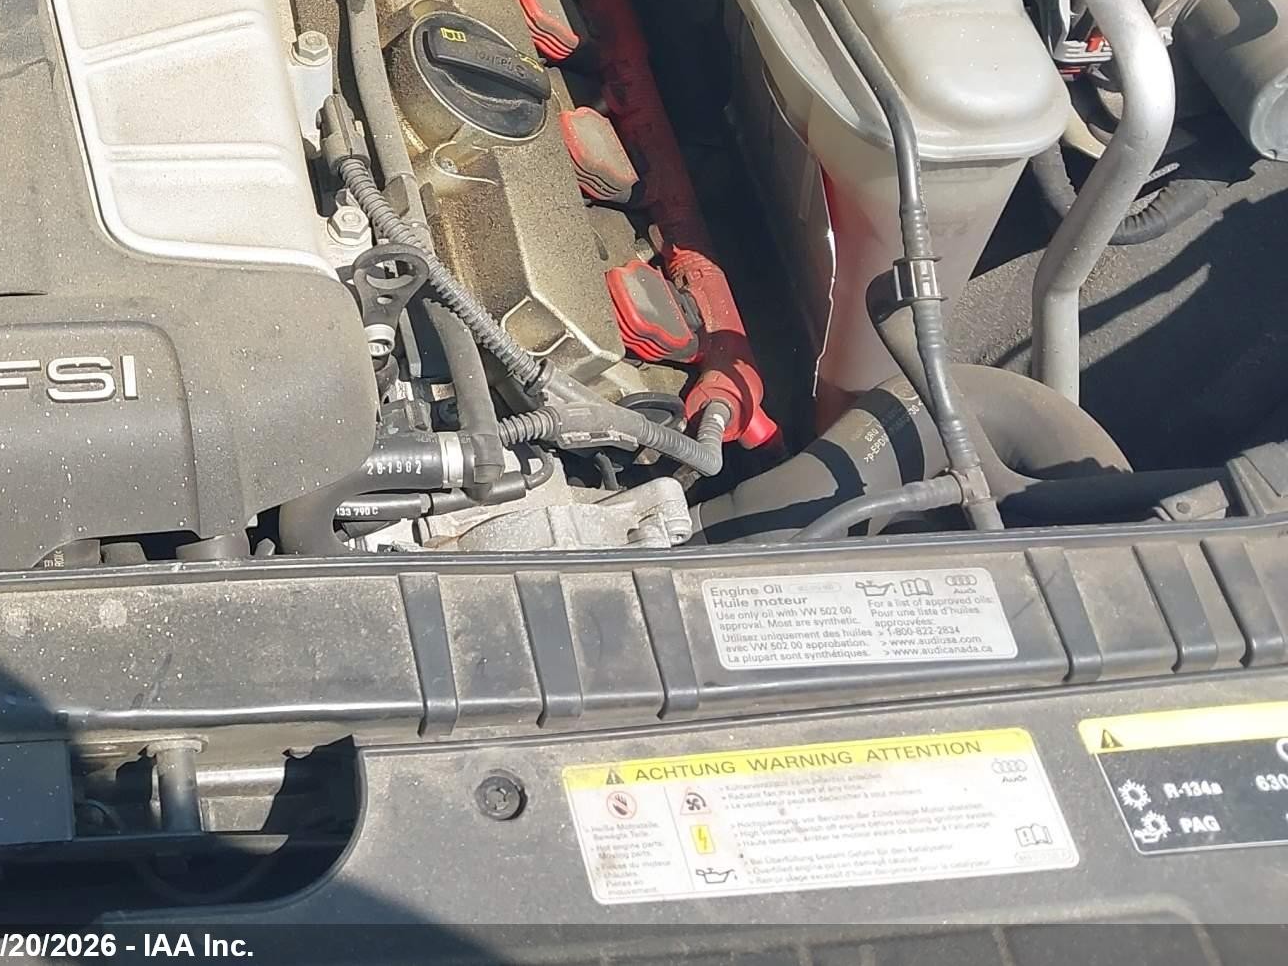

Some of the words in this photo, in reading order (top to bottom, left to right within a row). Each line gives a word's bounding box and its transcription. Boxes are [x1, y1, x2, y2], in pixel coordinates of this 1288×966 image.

[711, 585, 758, 599] Engine
[764, 584, 783, 595] Oil
[713, 597, 749, 609] Huile
[754, 595, 808, 607] moteur
[868, 599, 884, 609] For
[896, 598, 910, 608] list
[913, 597, 922, 607] of
[925, 596, 972, 608] approved
[716, 611, 736, 621] Use
[738, 609, 759, 621] only
[762, 609, 774, 619] oil
[778, 608, 798, 618] with
[800, 607, 817, 616] VW
[820, 606, 837, 616] 502
[840, 605, 852, 615] 00
[871, 608, 893, 618] Pour
[897, 609, 915, 617] une
[918, 606, 938, 616] liste
[768, 618, 792, 628] Most
[796, 618, 811, 627] are
[761, 630, 820, 643] uniquement
[823, 629, 840, 638] des
[843, 627, 872, 638] huiles
[890, 635, 982, 647] www.audiusa.com
[726, 644, 748, 653] avec
[750, 642, 767, 652] VW
[771, 641, 788, 651] 502
[791, 640, 803, 650] 00
[893, 645, 993, 657] www.audicanada.ca
[728, 654, 740, 664] La
[742, 651, 778, 664] plupart
[781, 650, 802, 660] sont
[635, 761, 736, 781] ACHTUNG
[746, 750, 853, 772] WARNING
[866, 740, 983, 763] ATTENTION
[1163, 779, 1223, 799] R-134a
[1179, 814, 1222, 833] PAG
